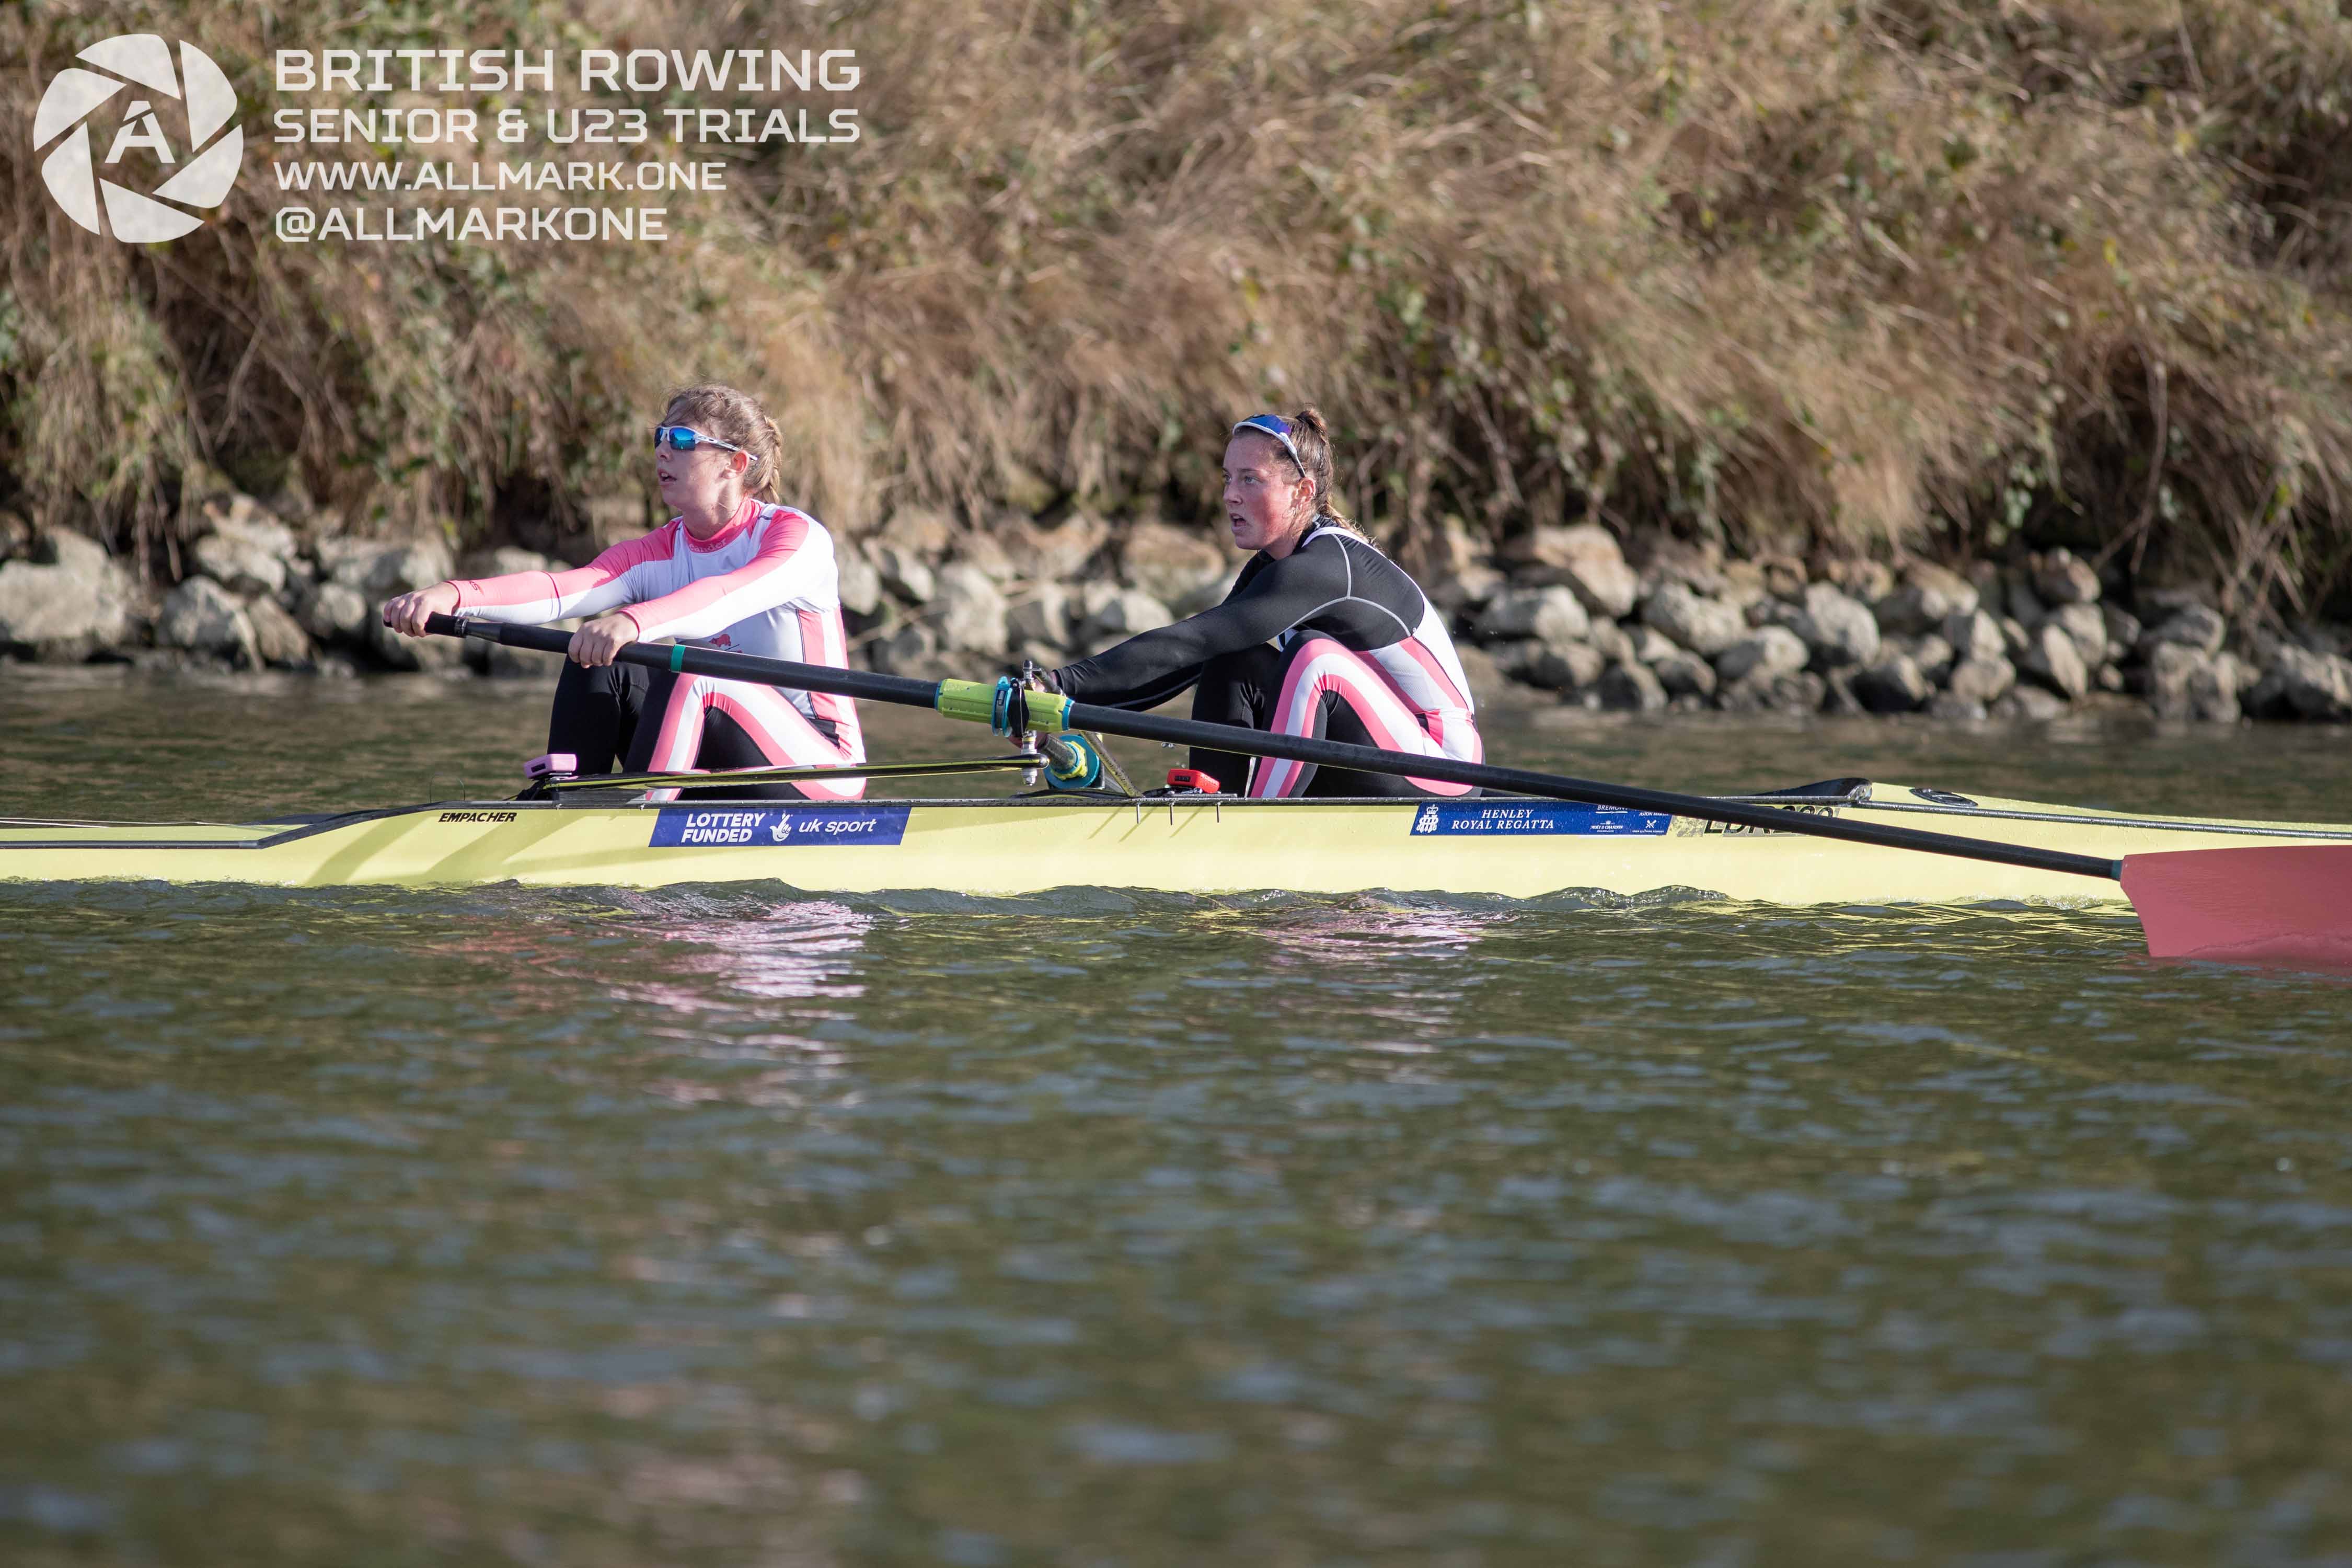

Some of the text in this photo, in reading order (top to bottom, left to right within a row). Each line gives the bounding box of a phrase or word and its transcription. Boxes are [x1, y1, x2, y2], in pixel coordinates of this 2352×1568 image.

[688, 538, 727, 552] eander
[439, 812, 517, 822] EMPACHER
[686, 813, 766, 827] LOTTERY
[1481, 809, 1534, 818] HENLEY
[799, 818, 877, 835] uk sport
[1451, 820, 1554, 829] ROYAL REGATTA
[681, 828, 753, 843] FUNDED
